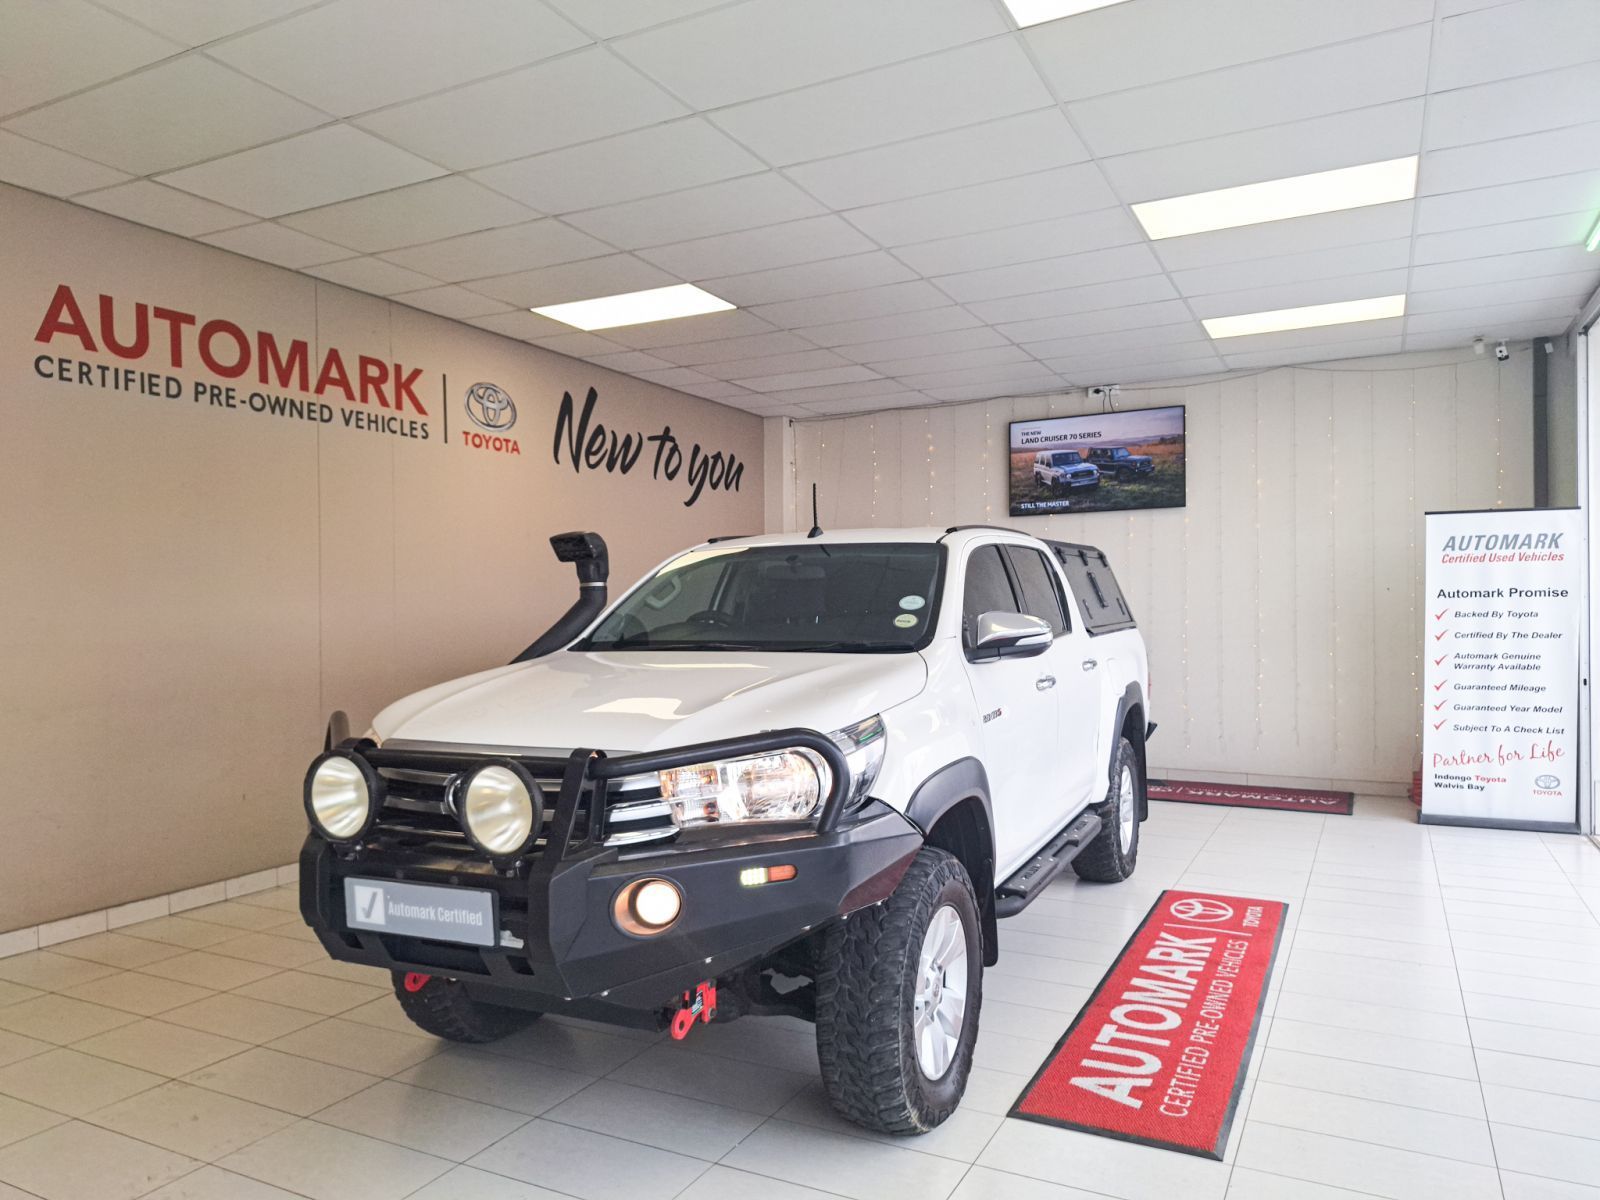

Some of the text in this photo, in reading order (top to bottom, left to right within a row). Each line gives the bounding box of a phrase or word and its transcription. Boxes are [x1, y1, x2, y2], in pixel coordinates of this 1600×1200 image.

[34, 284, 429, 417] AUTOMARK
[34, 354, 430, 440] CERTIFIED PRE-OWNED VEHICLES
[462, 431, 521, 455] TOYOTA
[1021, 437, 1039, 445] LAND
[1040, 434, 1068, 443] CRUISER
[1078, 431, 1102, 440] SERIES
[553, 386, 744, 507] New to you
[1047, 500, 1070, 508] MASTER
[1442, 532, 1564, 552] AUTOMARK
[1441, 552, 1565, 564] Certified Used Vehicles
[1437, 587, 1569, 599] Automark Promise
[1454, 610, 1539, 619] Backed By Toyota
[1454, 631, 1563, 640] Certified By The Dealer
[1453, 652, 1541, 660] Automark Genuine
[1454, 663, 1541, 671] Warranty Available
[1453, 683, 1547, 693] Guaranteed Mileage
[1453, 703, 1563, 713] Guaranteed Year Model
[1453, 724, 1488, 733] Subject
[1513, 726, 1543, 734] Check
[1546, 727, 1565, 735] List
[1433, 740, 1566, 769] Partner for Life
[1434, 773, 1507, 784] Indongo Toyota
[1434, 782, 1485, 792] Walvis Bay
[388, 901, 483, 927] Automark Certified
[1242, 906, 1264, 928] TOYOTA
[1069, 931, 1217, 1110] AUTOMARK
[1159, 939, 1249, 1118] CERTIFIED PRE-OWNED VEHICLES
